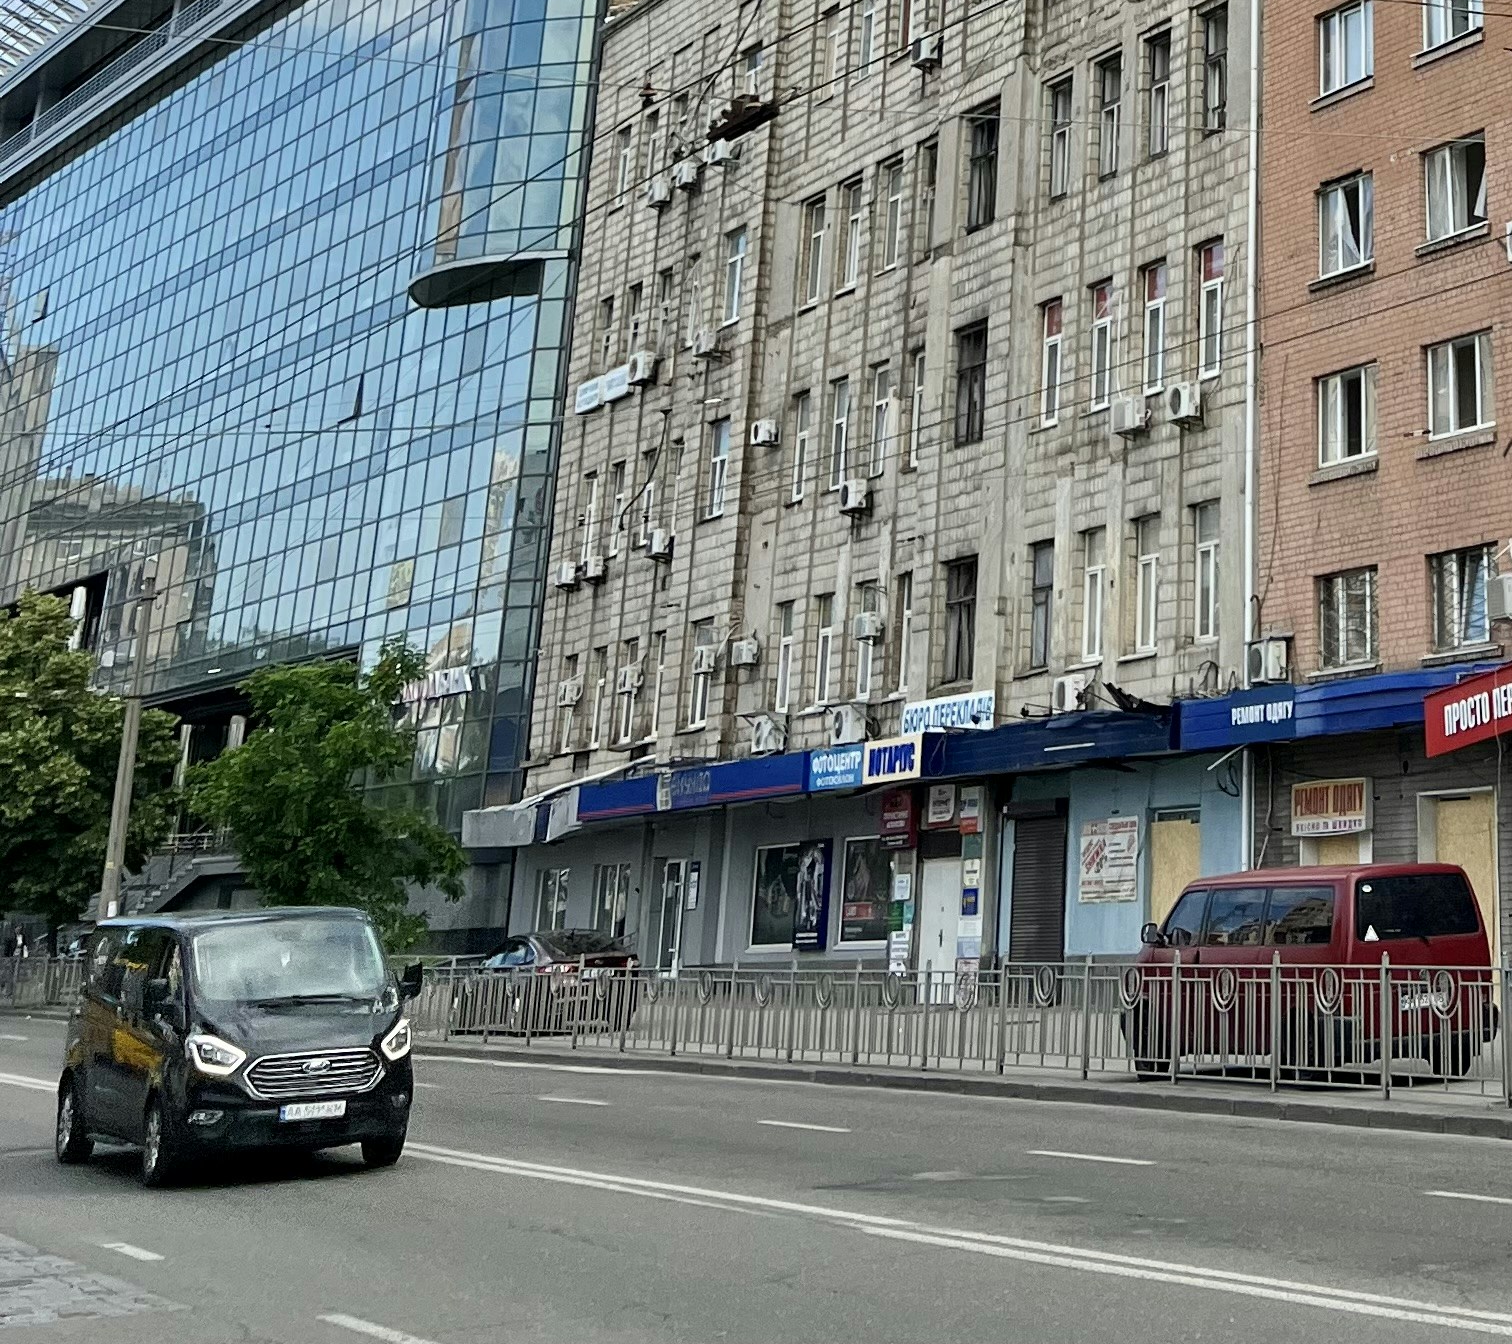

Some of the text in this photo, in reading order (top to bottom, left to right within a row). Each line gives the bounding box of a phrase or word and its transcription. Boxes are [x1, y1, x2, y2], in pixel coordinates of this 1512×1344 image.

[904, 706, 930, 733] БЮРО
[1231, 700, 1294, 725] РЕМОНТ ОДЯГУ
[1444, 692, 1490, 736] ПРОСТО
[812, 751, 861, 773] ФОТОЦЕНТР
[1294, 783, 1364, 816] РЕМОНТ ОДЯГУ
